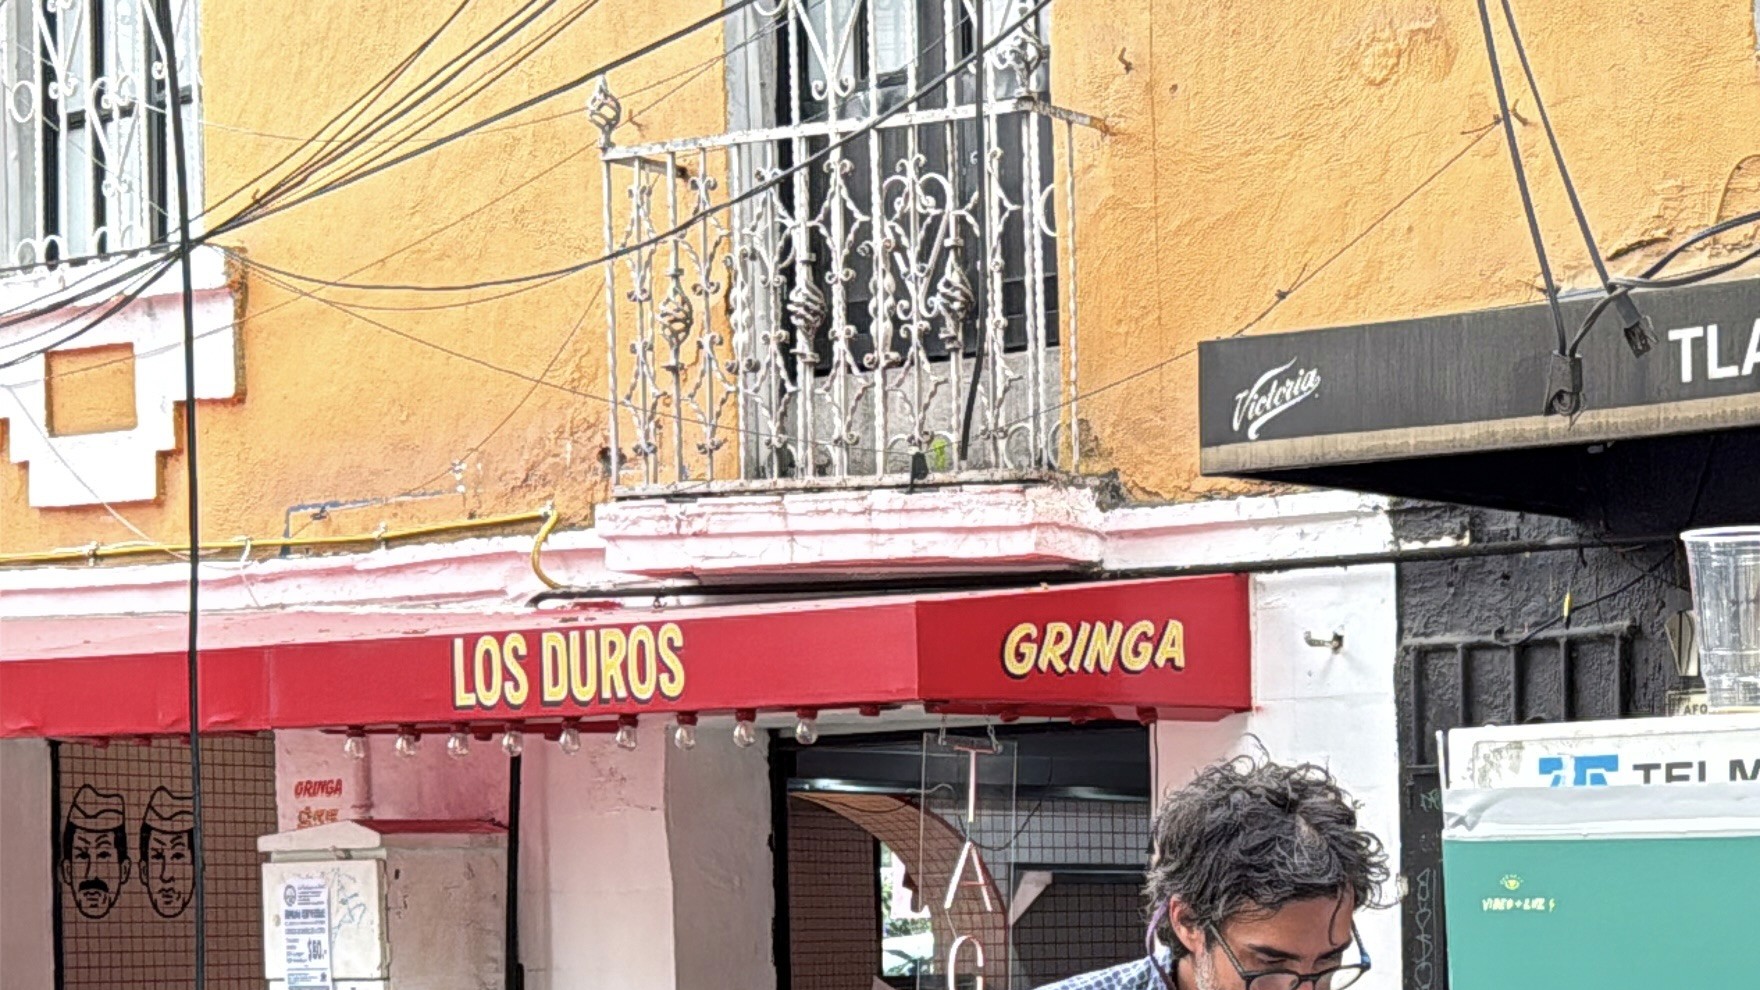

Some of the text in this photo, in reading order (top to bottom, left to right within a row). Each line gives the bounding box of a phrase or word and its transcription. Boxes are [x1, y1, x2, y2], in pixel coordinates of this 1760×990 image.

[1232, 355, 1321, 440] Victoria
[453, 622, 686, 710] LOS DUROS
[1002, 618, 1187, 679] GRINGA
